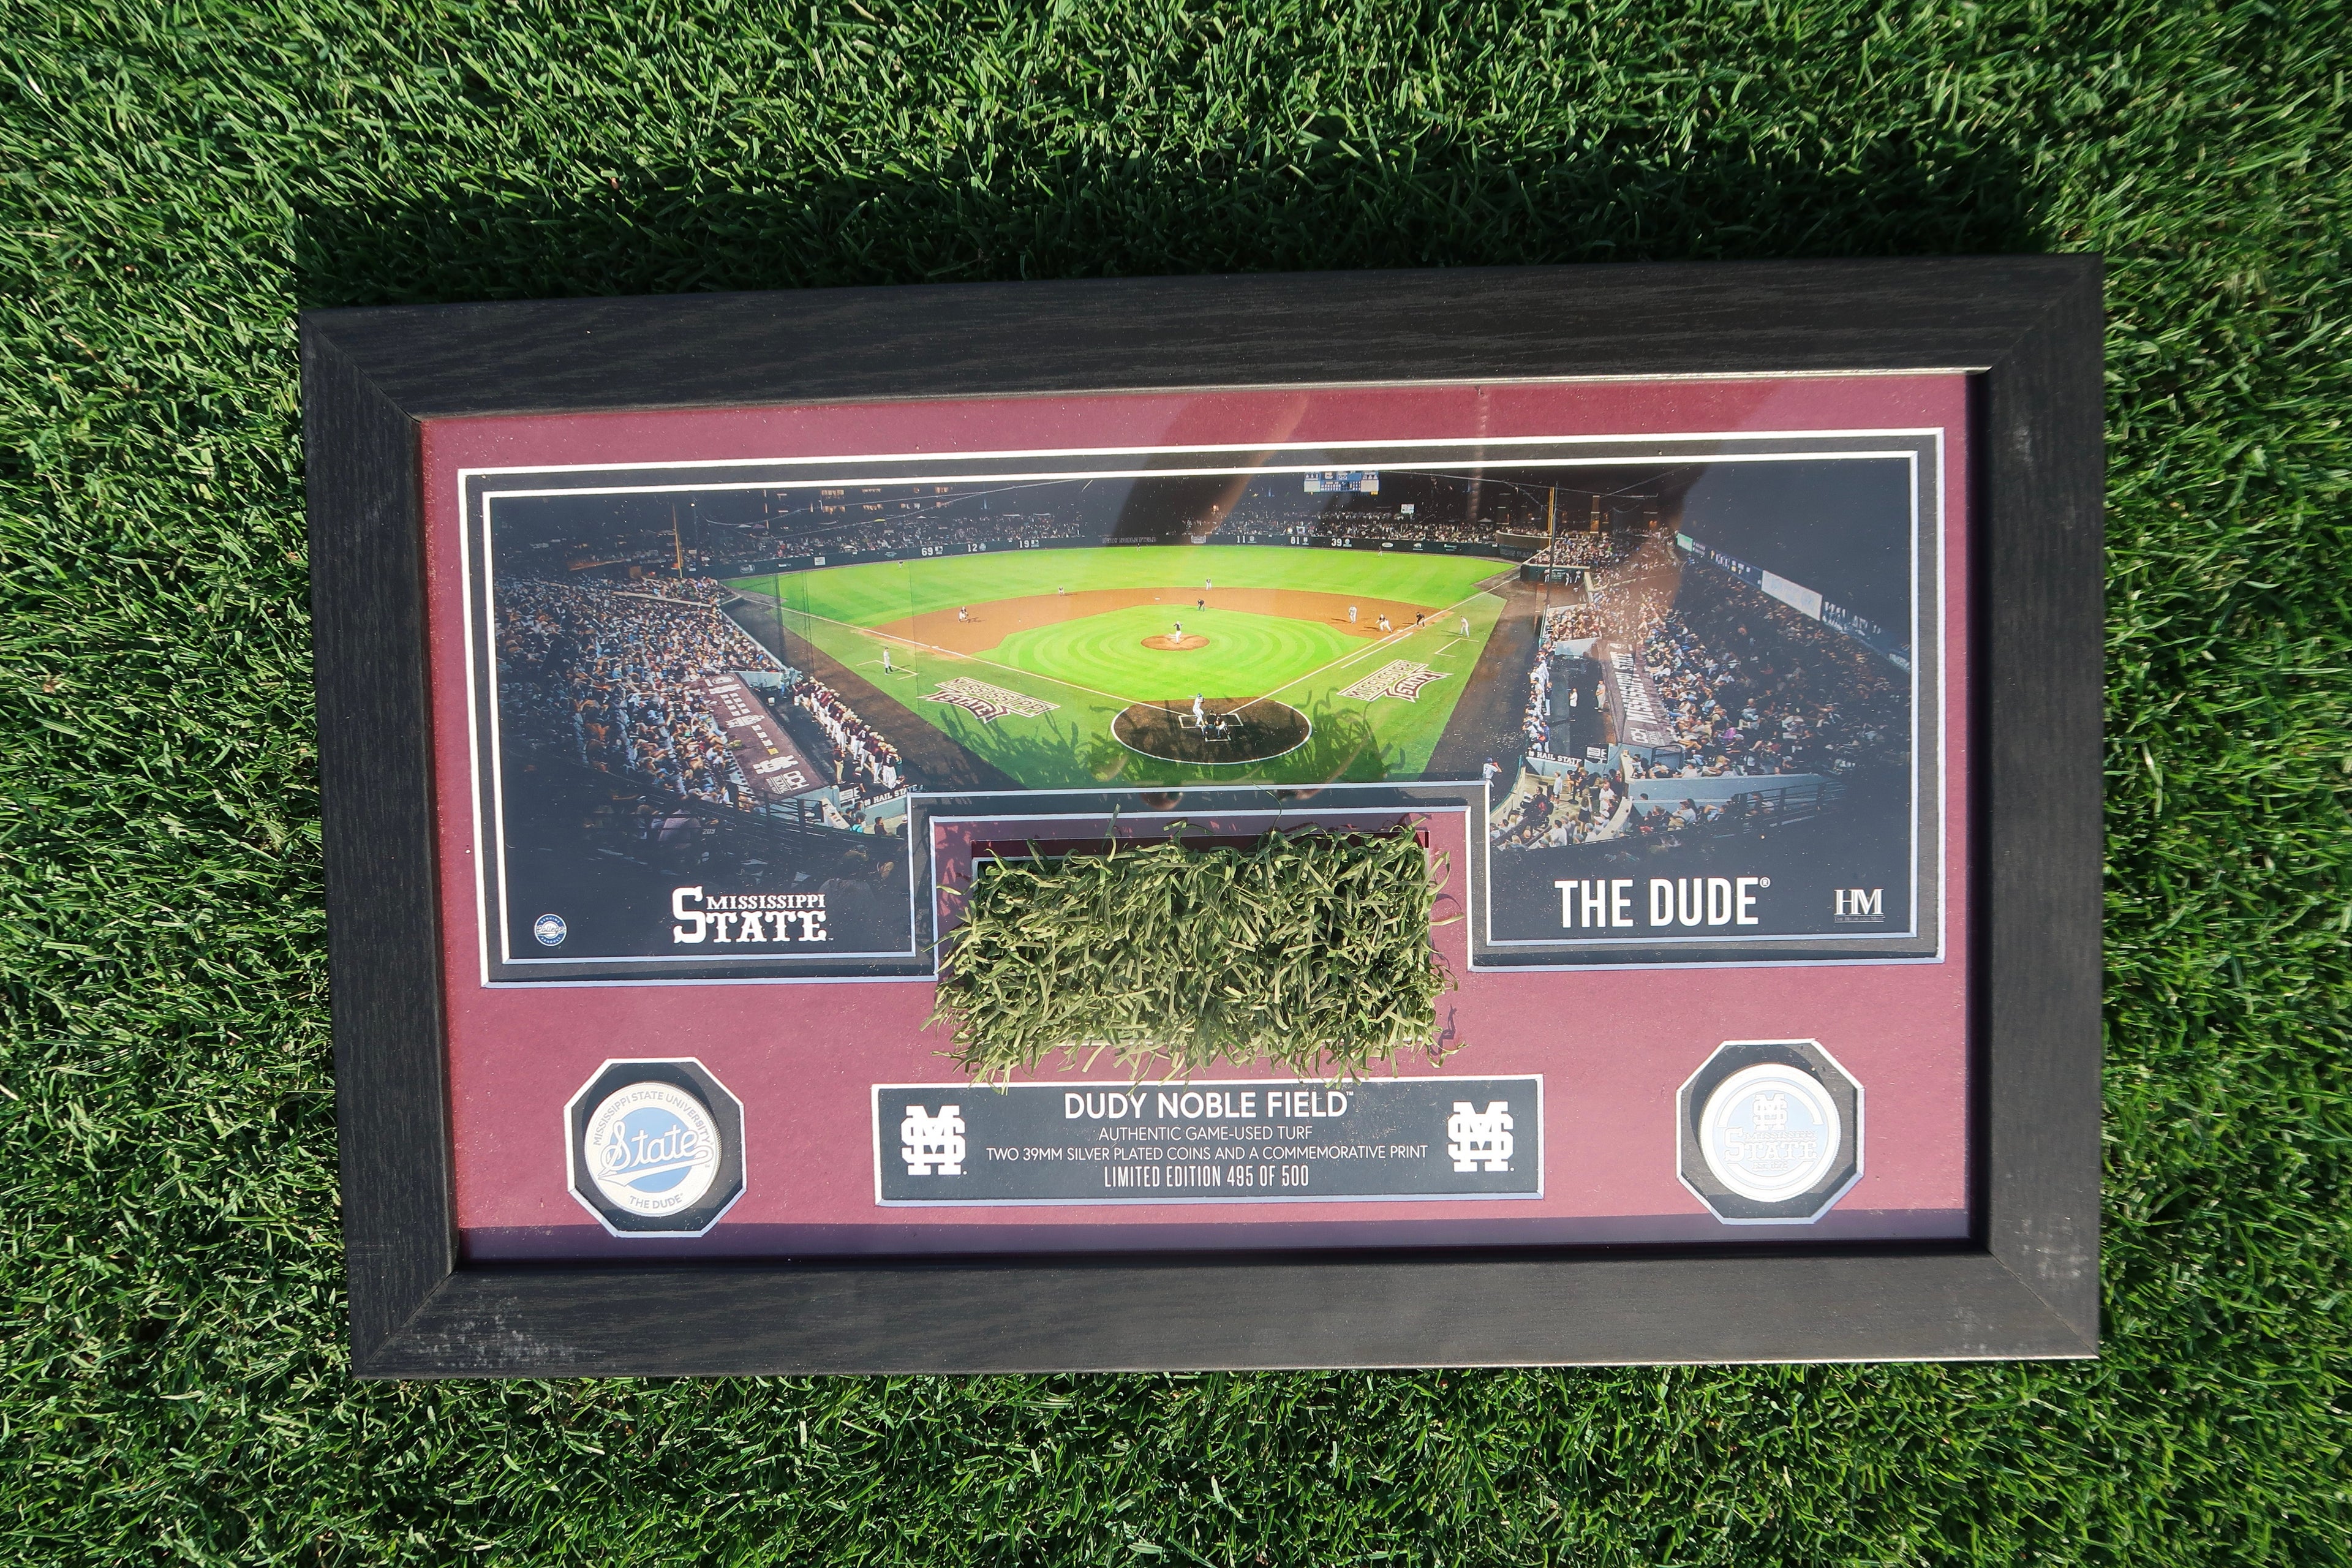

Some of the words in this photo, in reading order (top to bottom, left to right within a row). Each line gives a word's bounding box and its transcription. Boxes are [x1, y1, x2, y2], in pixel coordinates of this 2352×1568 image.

[921, 548, 933, 556] 69
[968, 543, 978, 552] 12
[1331, 538, 1342, 546] 39
[1346, 660, 1422, 699] MISSISSIPPI
[1396, 673, 1438, 695] STATE
[938, 694, 993, 716] STATE
[944, 678, 1053, 715] MISSISSIPPI
[1537, 752, 1556, 761] HAIL
[1557, 755, 1582, 765] STATE
[873, 793, 892, 804] HAIL
[894, 784, 918, 797] STATE
[706, 894, 826, 910] MISSISSIPPI
[1555, 879, 1634, 928] THE
[1065, 1092, 1147, 1119] DUDY
[1158, 1091, 1256, 1119] NOBLE
[593, 1096, 631, 1146] MISSISSIPPI
[631, 1091, 664, 1102] STATE
[1098, 1126, 1182, 1141] AUTHENTIC
[1185, 1126, 1273, 1140] GAME-USED
[1276, 1125, 1313, 1140] TURF
[599, 1120, 701, 1171] State
[986, 1147, 1019, 1161] TWO
[1023, 1147, 1063, 1161] 39MM
[1067, 1147, 1110, 1161] SILVER
[1114, 1147, 1163, 1161] PLATED
[1167, 1147, 1211, 1160] COINS
[1215, 1147, 1245, 1160] AND
[1249, 1147, 1259, 1159] A
[1262, 1145, 1386, 1160] COMMEMORATIVE
[1390, 1145, 1428, 1158] PRINT
[1104, 1166, 1160, 1188] LIMITED
[1166, 1165, 1221, 1187] EDITION
[1226, 1165, 1253, 1187] 495
[1259, 1165, 1276, 1186] OF
[1281, 1164, 1309, 1186] 500
[629, 1195, 649, 1208] THE
[652, 1195, 680, 1209] DUDE
